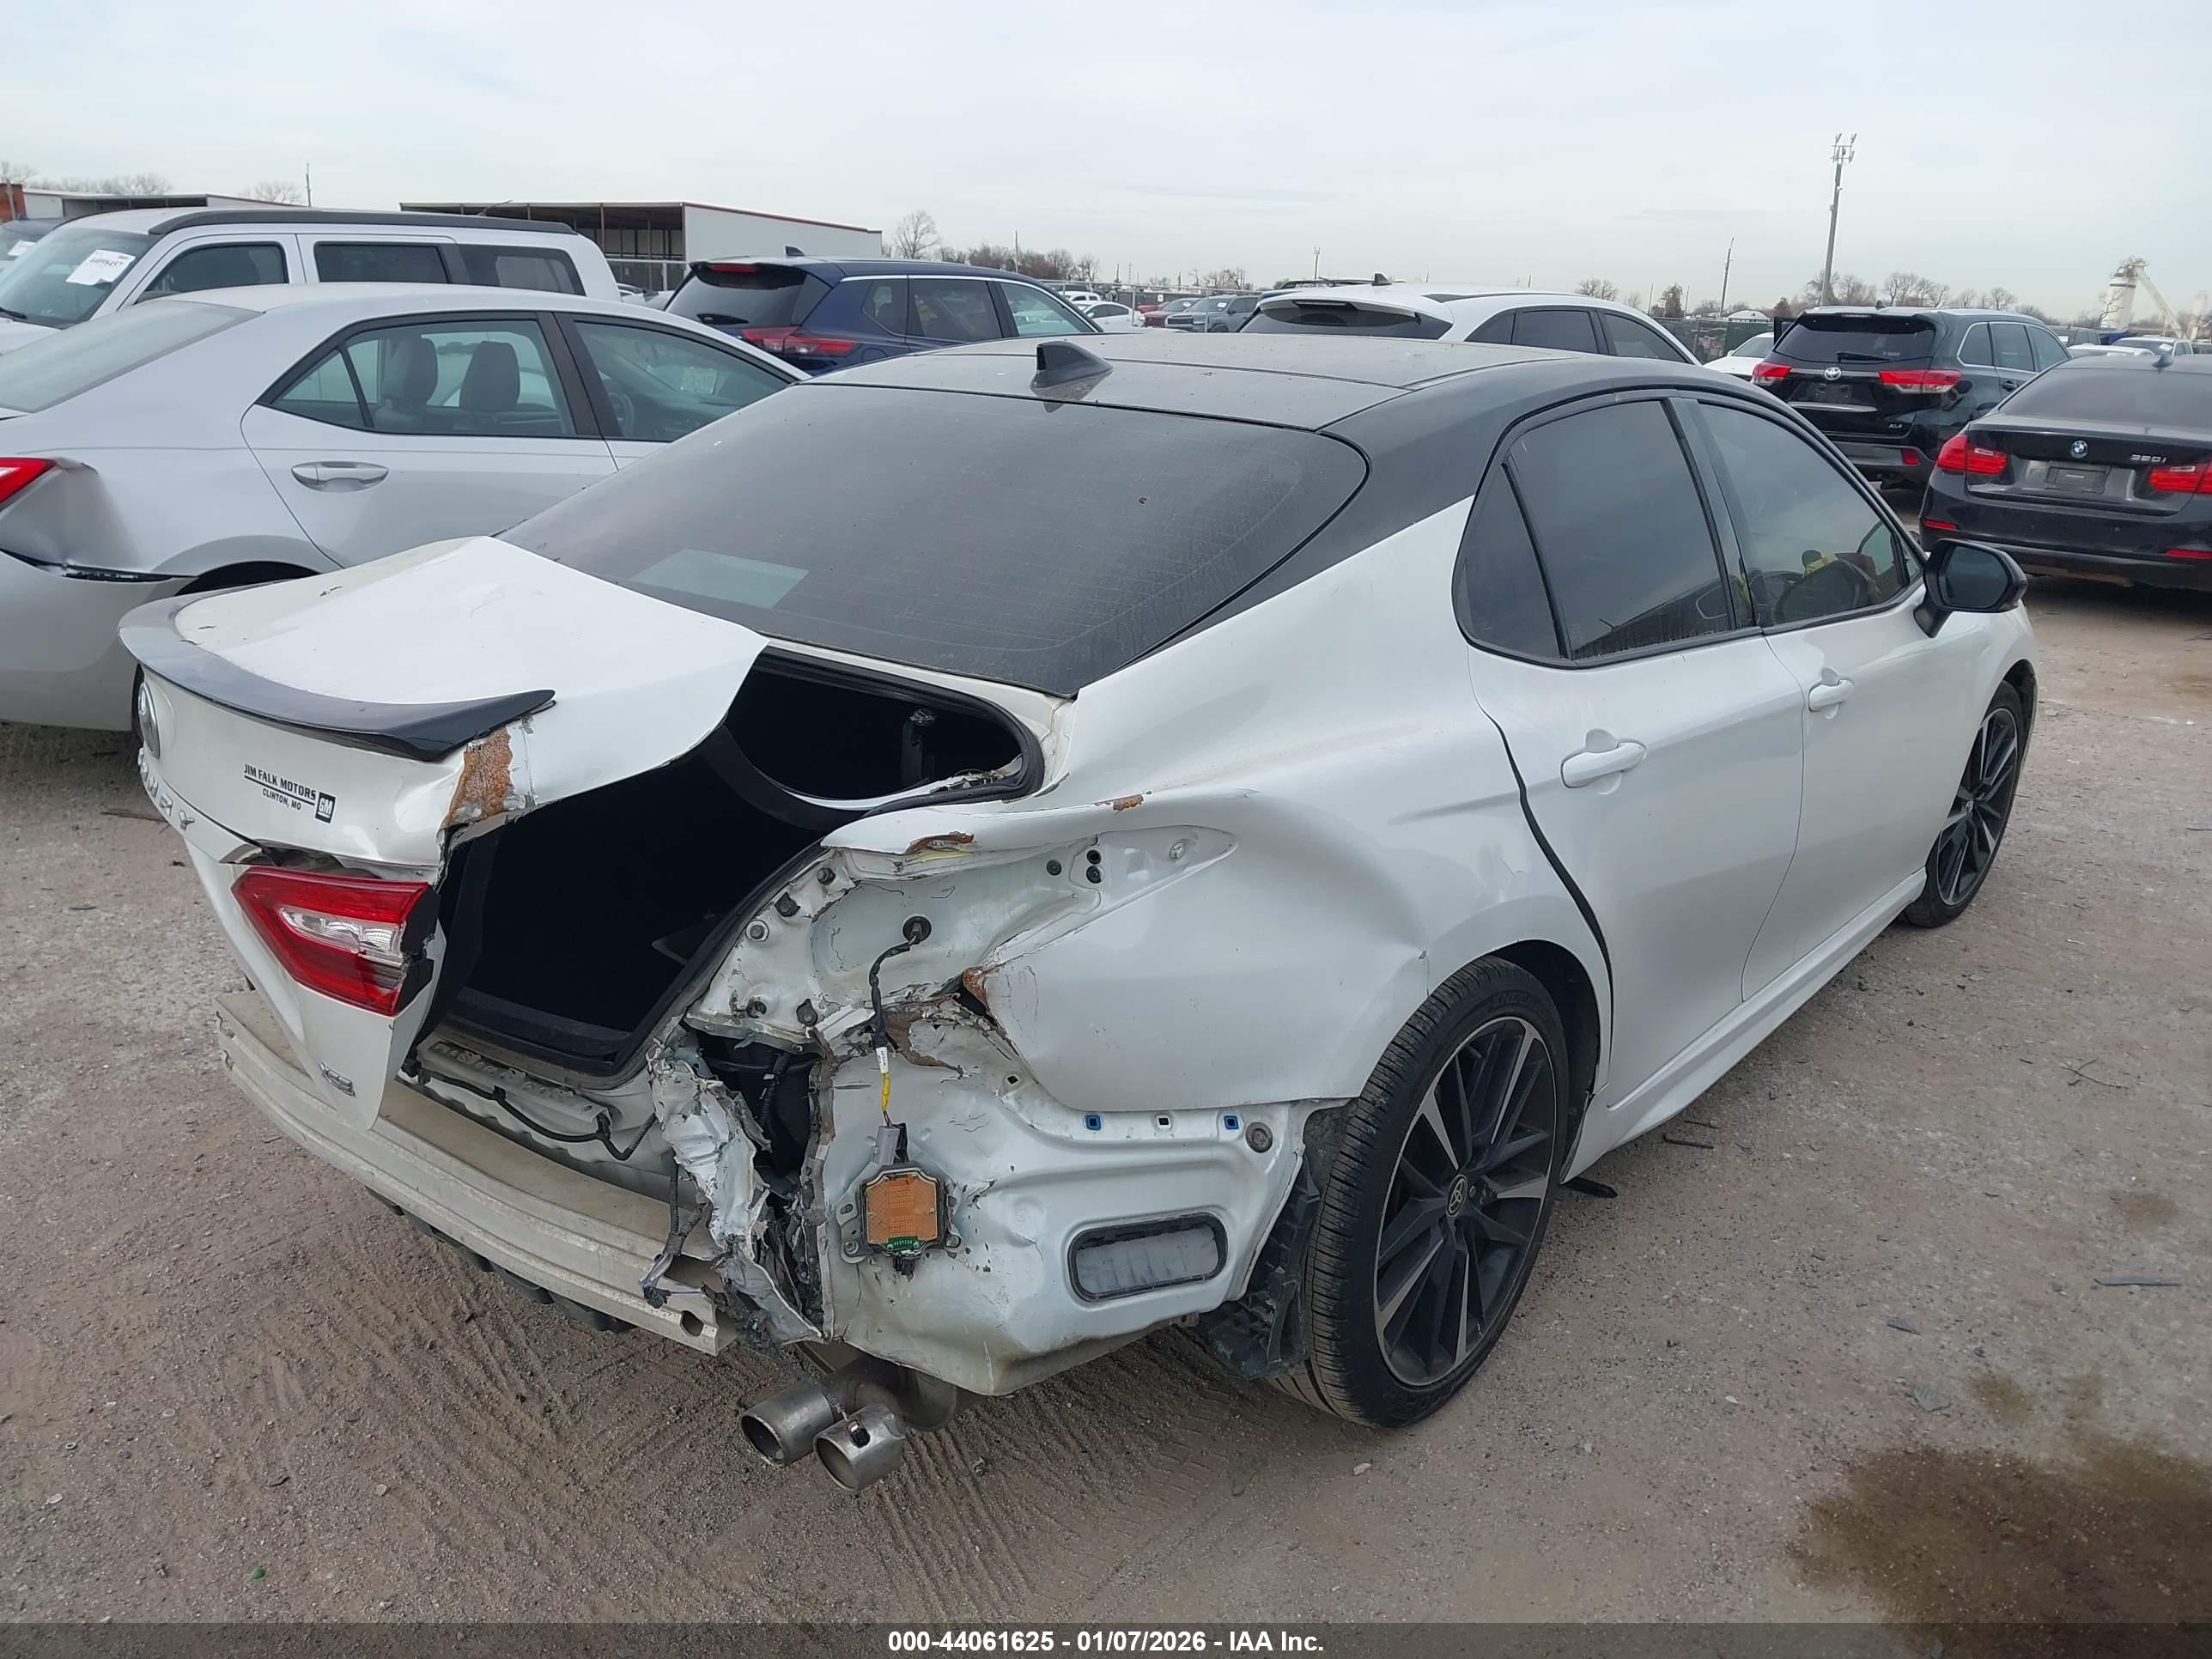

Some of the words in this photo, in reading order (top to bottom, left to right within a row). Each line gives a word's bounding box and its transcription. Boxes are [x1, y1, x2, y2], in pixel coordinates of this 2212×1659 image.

[244, 763, 257, 777] JIM
[258, 769, 278, 787] FALK
[280, 777, 317, 800] MOTORS
[262, 788, 289, 807] CLINTON,
[290, 799, 302, 811] MO
[318, 795, 334, 819] GM
